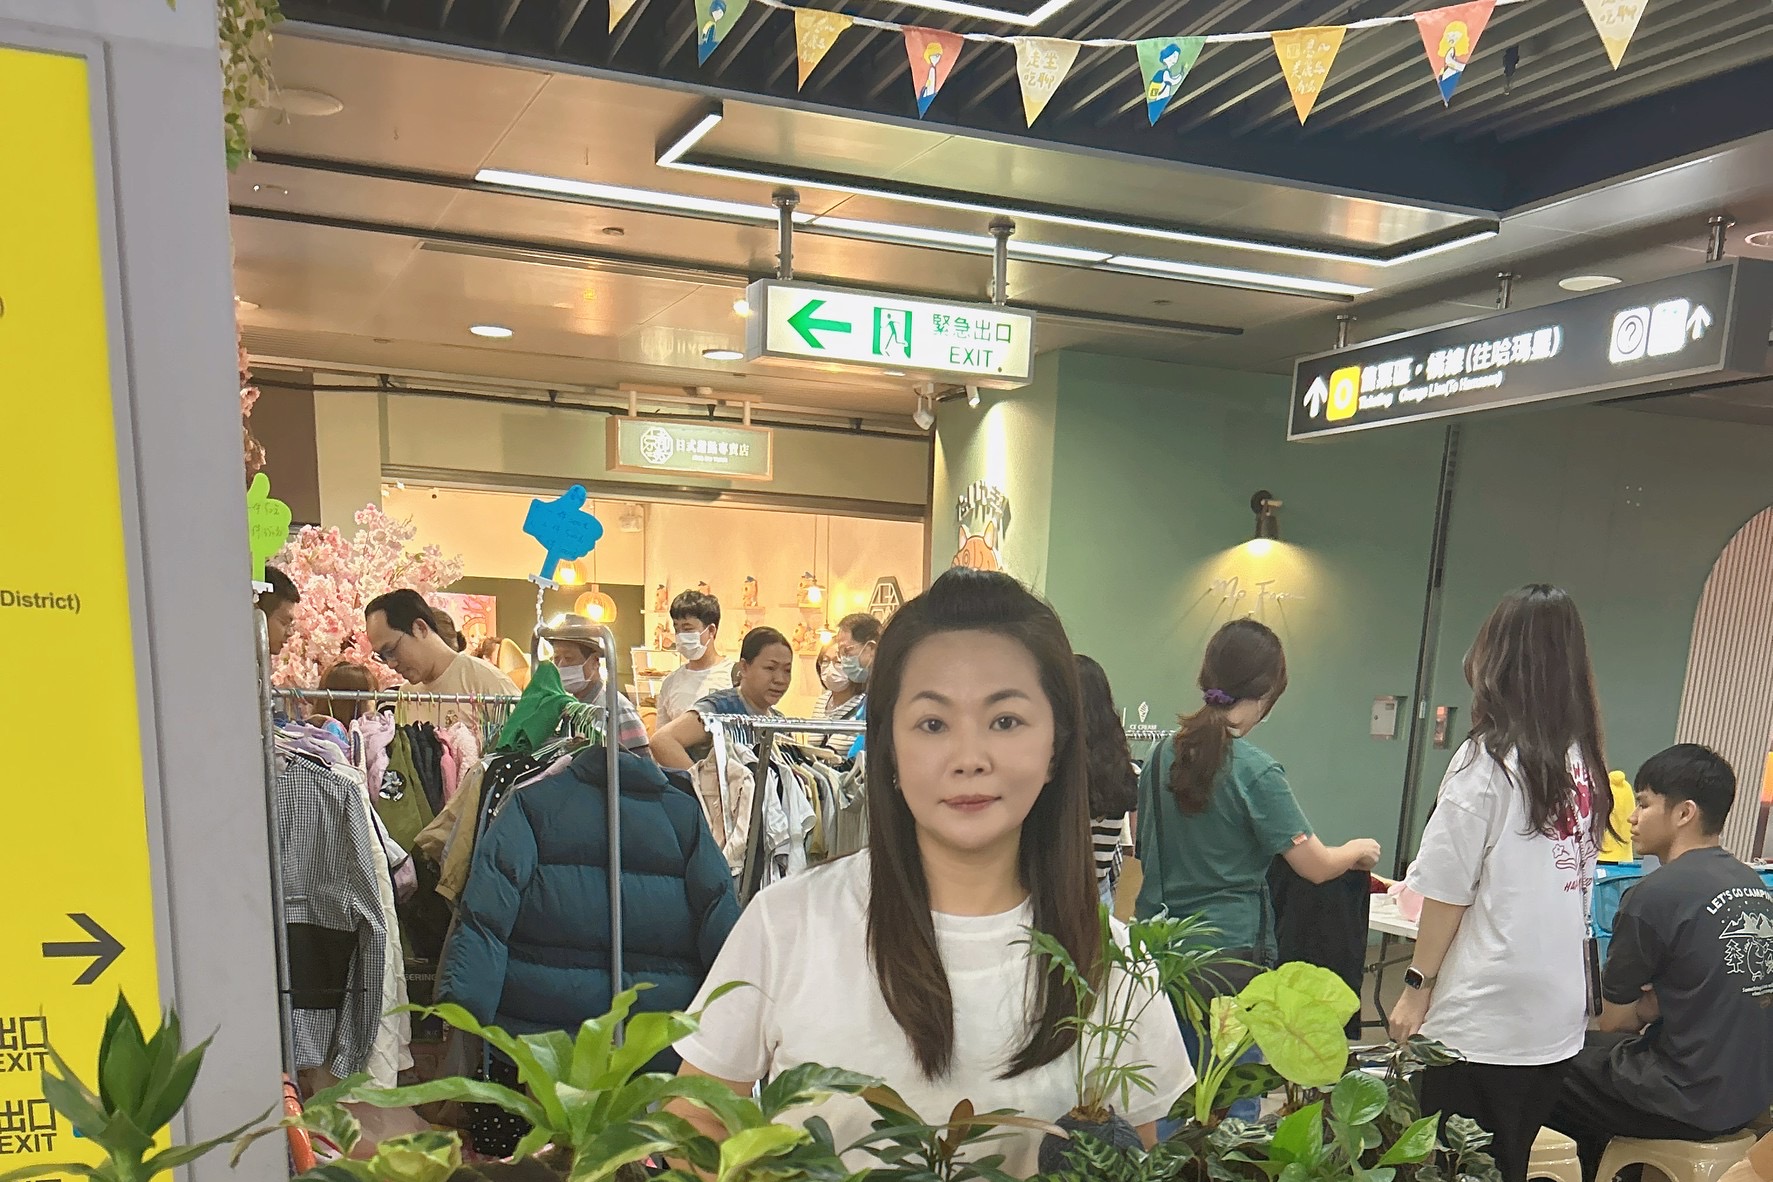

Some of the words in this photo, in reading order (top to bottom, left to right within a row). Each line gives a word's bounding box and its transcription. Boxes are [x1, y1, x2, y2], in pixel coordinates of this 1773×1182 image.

[932, 313, 1012, 343] 緊急出口
[949, 346, 994, 367] EXIT
[0, 590, 81, 615] District)
[1706, 890, 1733, 916] LET'S
[1731, 887, 1743, 899] GO
[0, 1099, 57, 1133] 出口
[0, 1132, 57, 1154] EXIT
